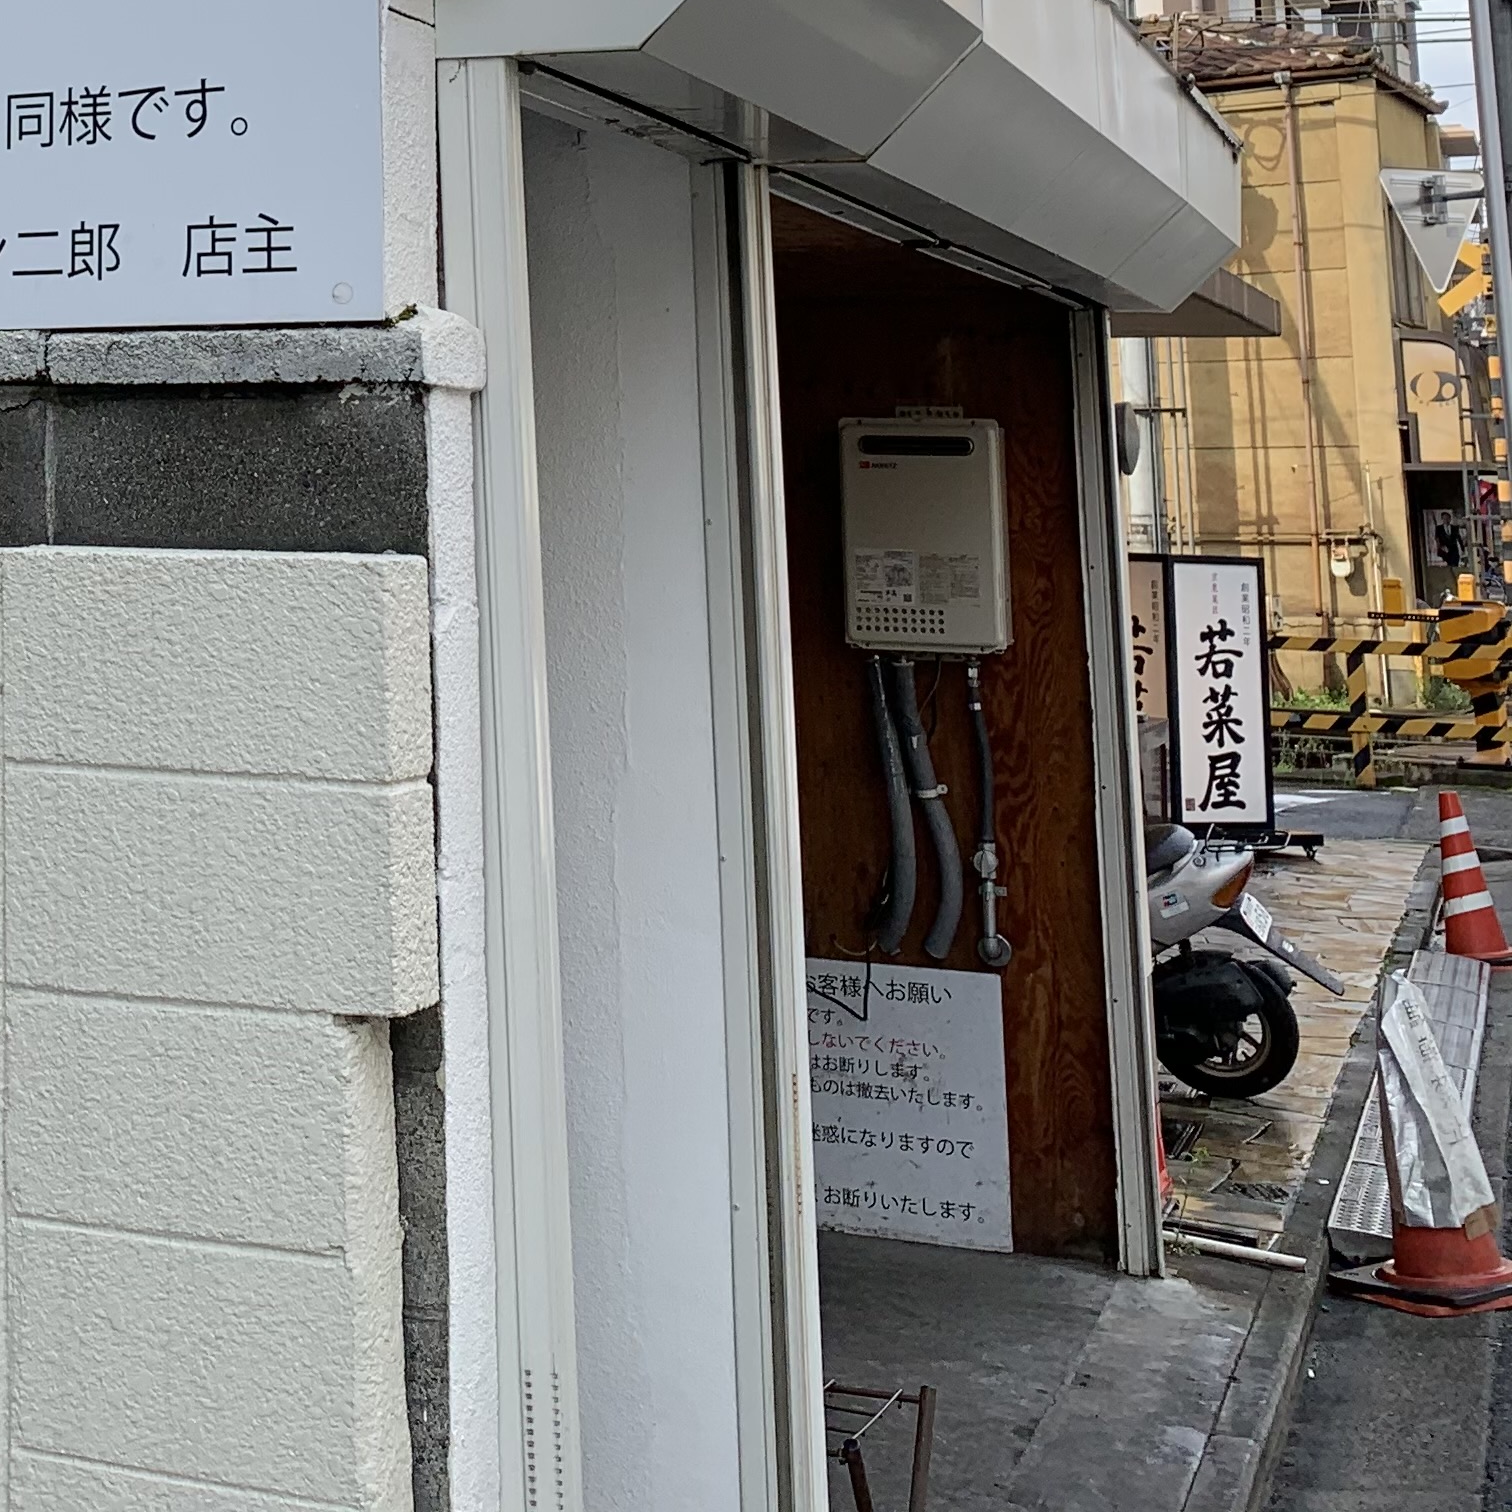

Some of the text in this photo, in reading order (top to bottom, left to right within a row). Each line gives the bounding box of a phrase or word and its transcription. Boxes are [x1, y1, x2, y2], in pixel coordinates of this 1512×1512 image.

[181, 213, 298, 279] 店主
[1194, 618, 1247, 813] 若菜屋
